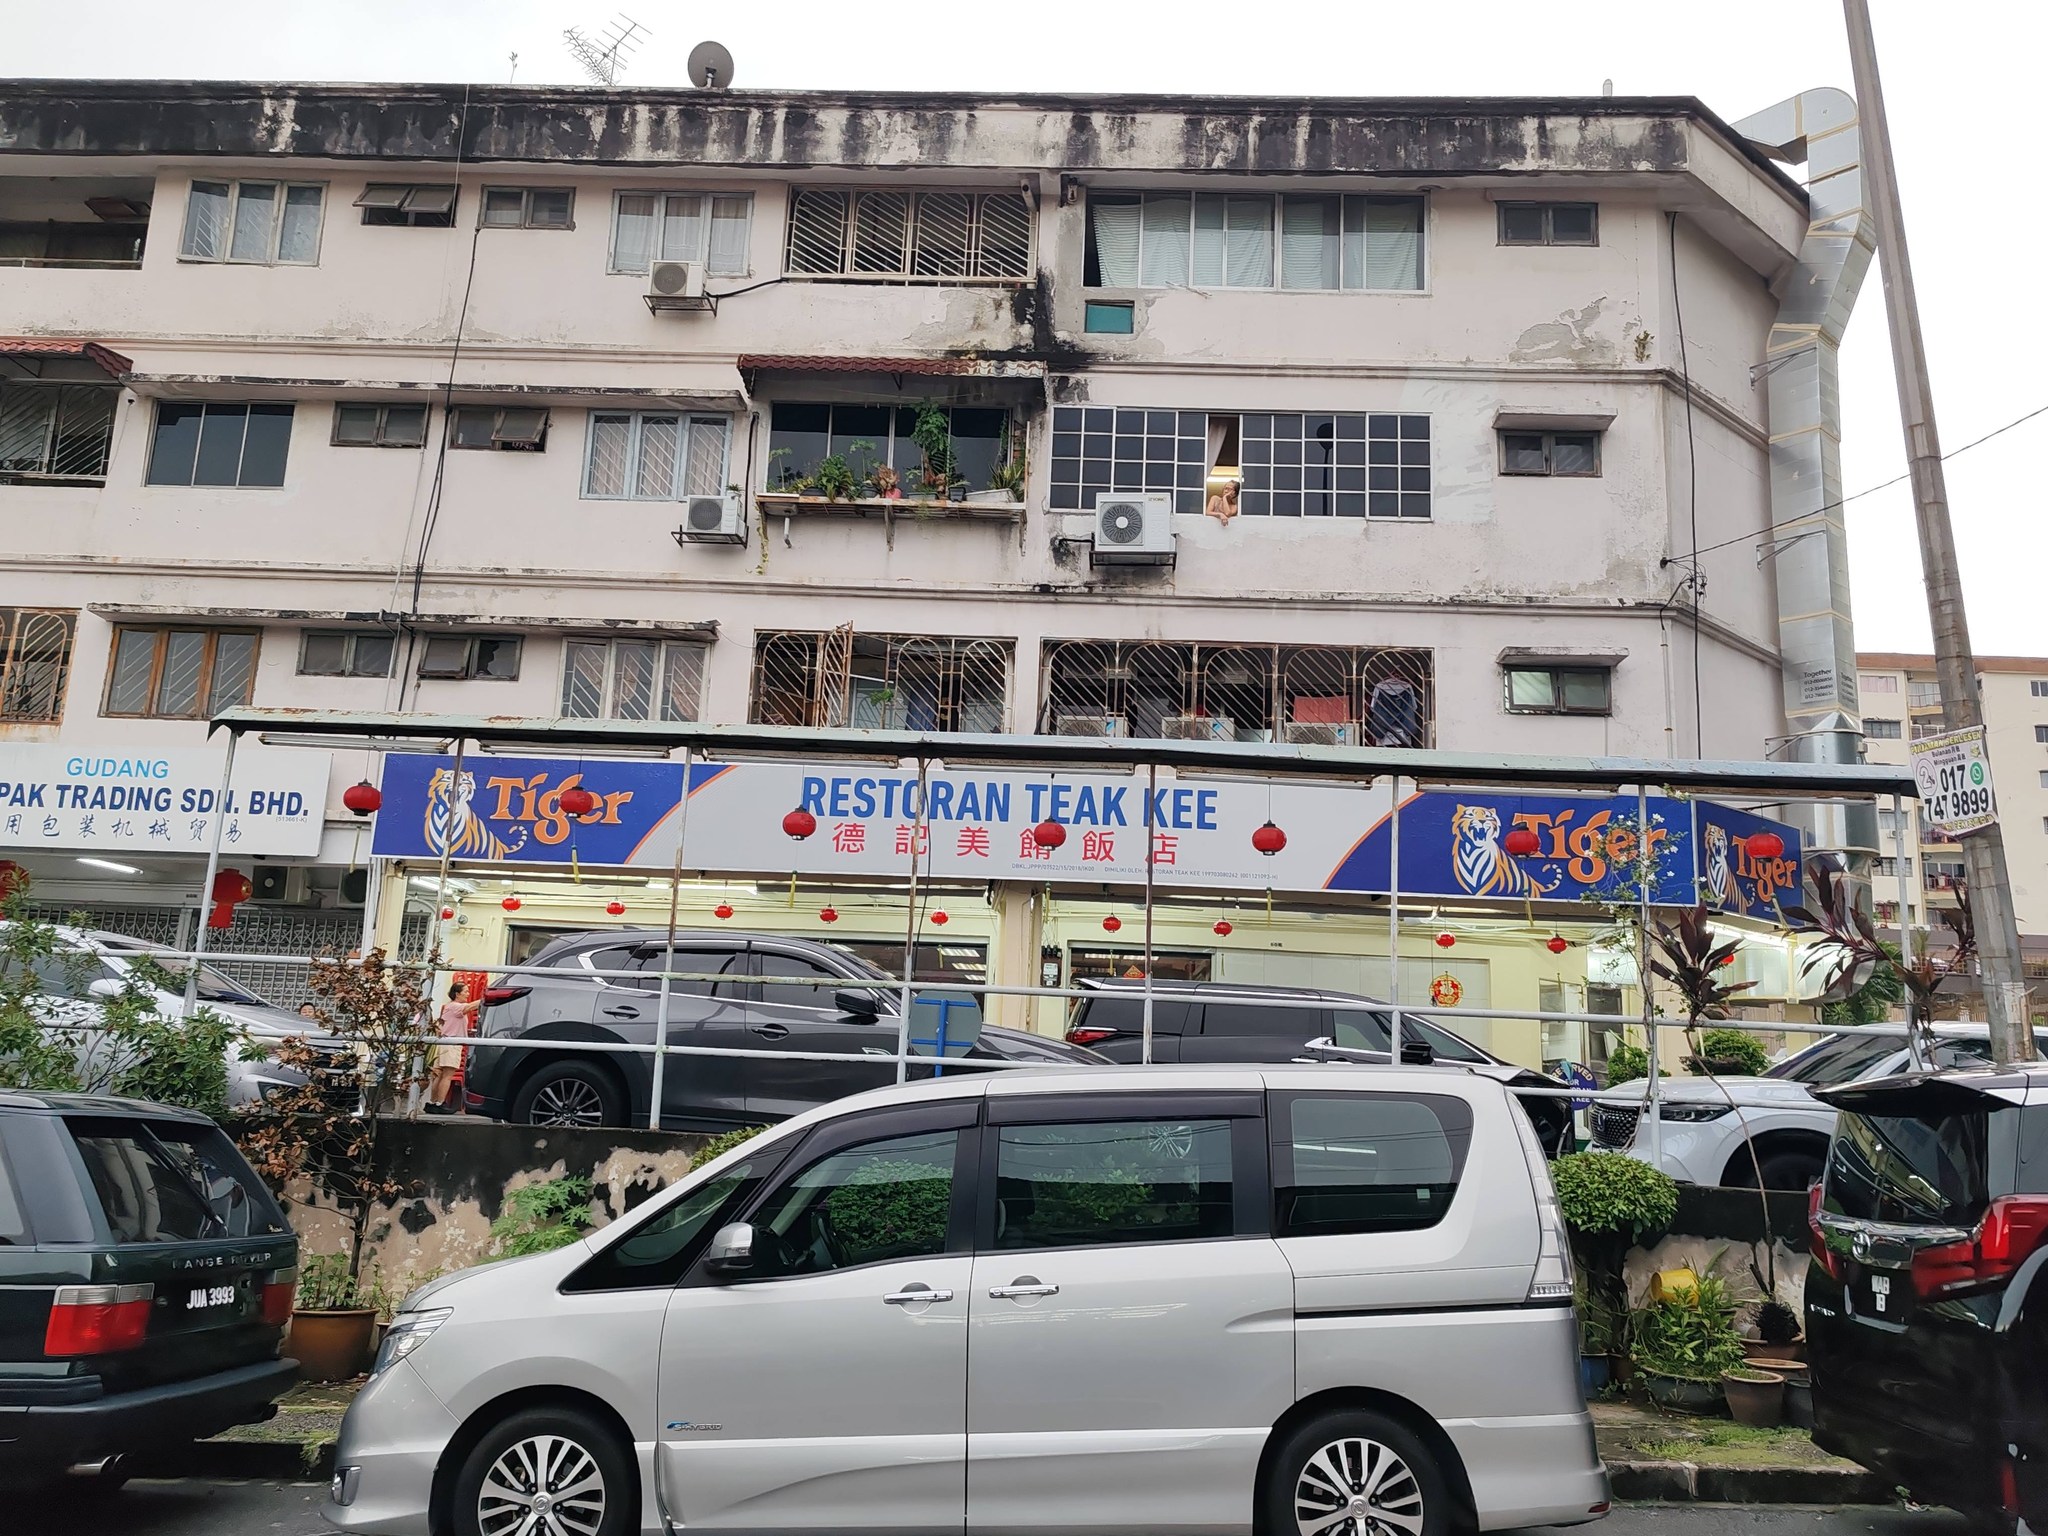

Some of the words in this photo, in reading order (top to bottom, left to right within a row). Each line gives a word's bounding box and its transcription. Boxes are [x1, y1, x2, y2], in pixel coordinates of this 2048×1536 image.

[66, 757, 169, 779] GUDANG
[1940, 764, 1966, 793] 017
[0, 782, 48, 808] PAK
[55, 784, 173, 812] TRADING
[180, 788, 240, 814] SDN.
[248, 790, 310, 817] BHD.
[801, 776, 1009, 823] RESTORAN
[1025, 783, 1128, 827] TEAK
[1142, 787, 1218, 831] KEE
[1924, 795, 1949, 821] 747
[1951, 787, 1989, 817] 9899
[186, 1288, 208, 1310] JUA
[208, 1285, 235, 1306] 3993
